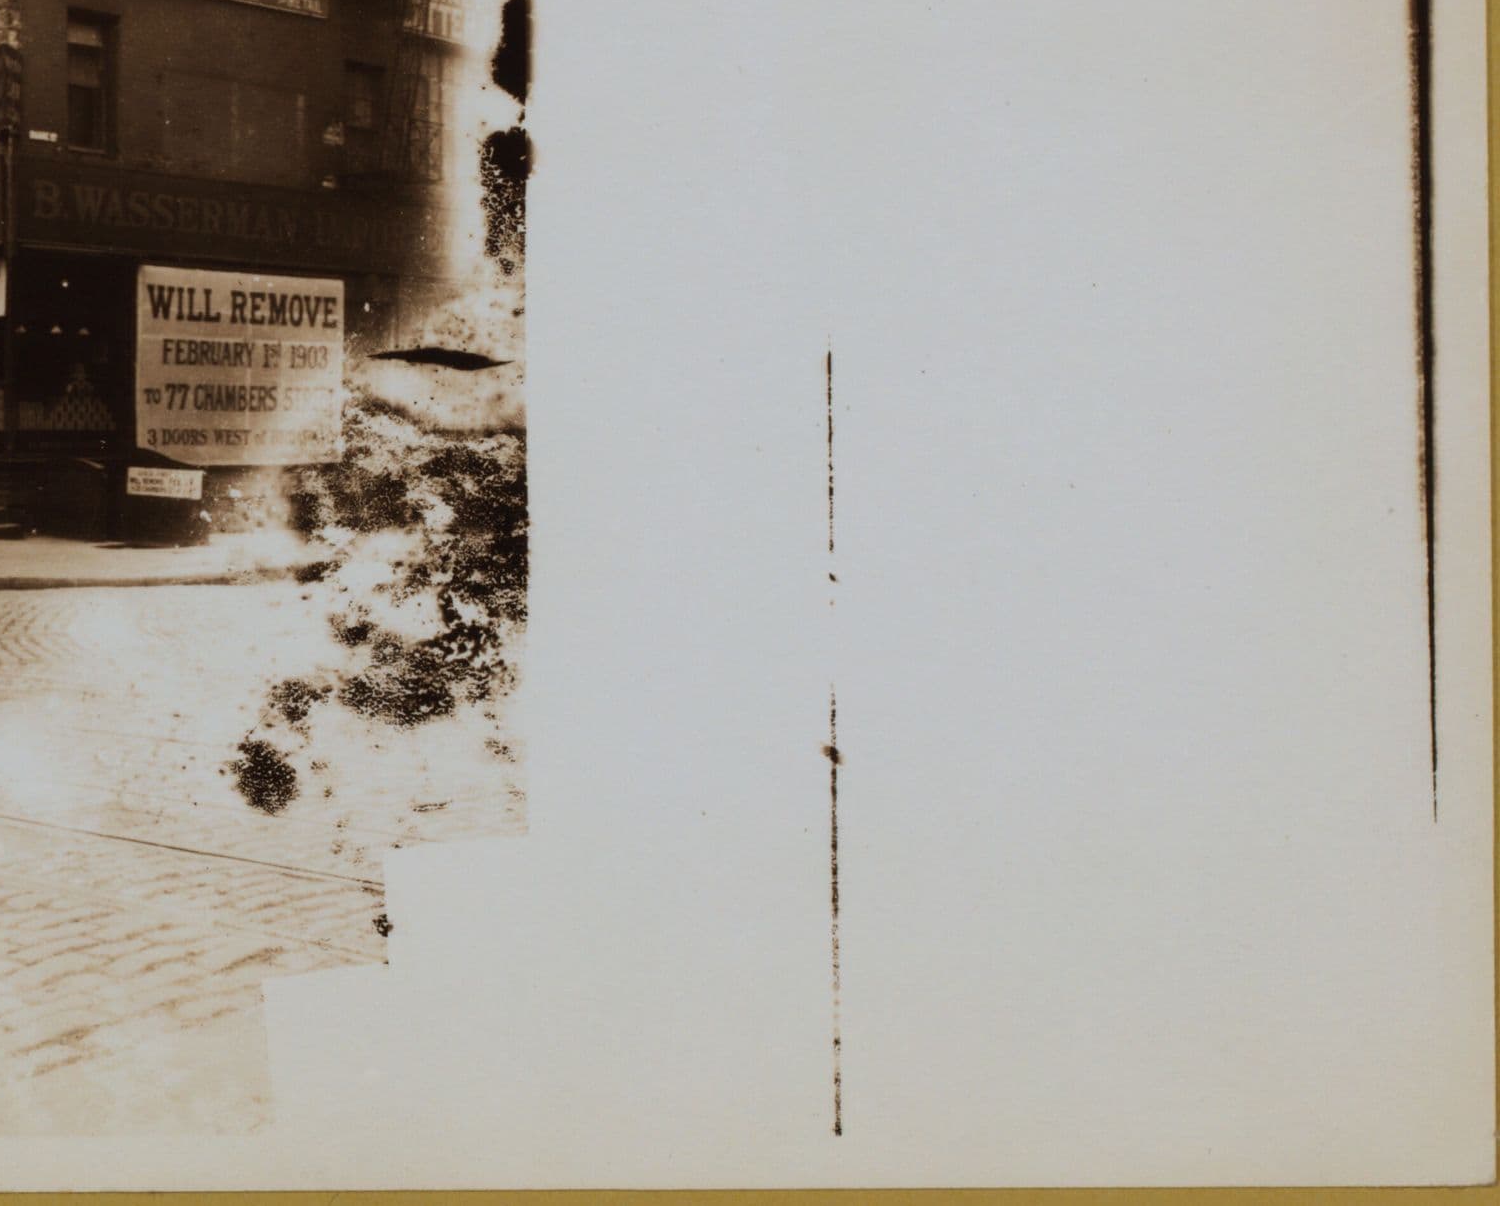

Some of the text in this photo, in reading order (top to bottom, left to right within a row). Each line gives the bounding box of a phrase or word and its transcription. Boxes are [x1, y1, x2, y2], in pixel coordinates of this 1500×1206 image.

[146, 283, 338, 329] WILL REMOVE
[162, 338, 254, 368] FEBRUARY
[290, 344, 329, 369] 1903
[144, 387, 161, 405] TO
[165, 383, 190, 411] 77
[193, 384, 278, 412] CHAMBERS
[147, 429, 158, 447] 3
[162, 429, 207, 446] DOORS
[213, 429, 252, 445] WEST
